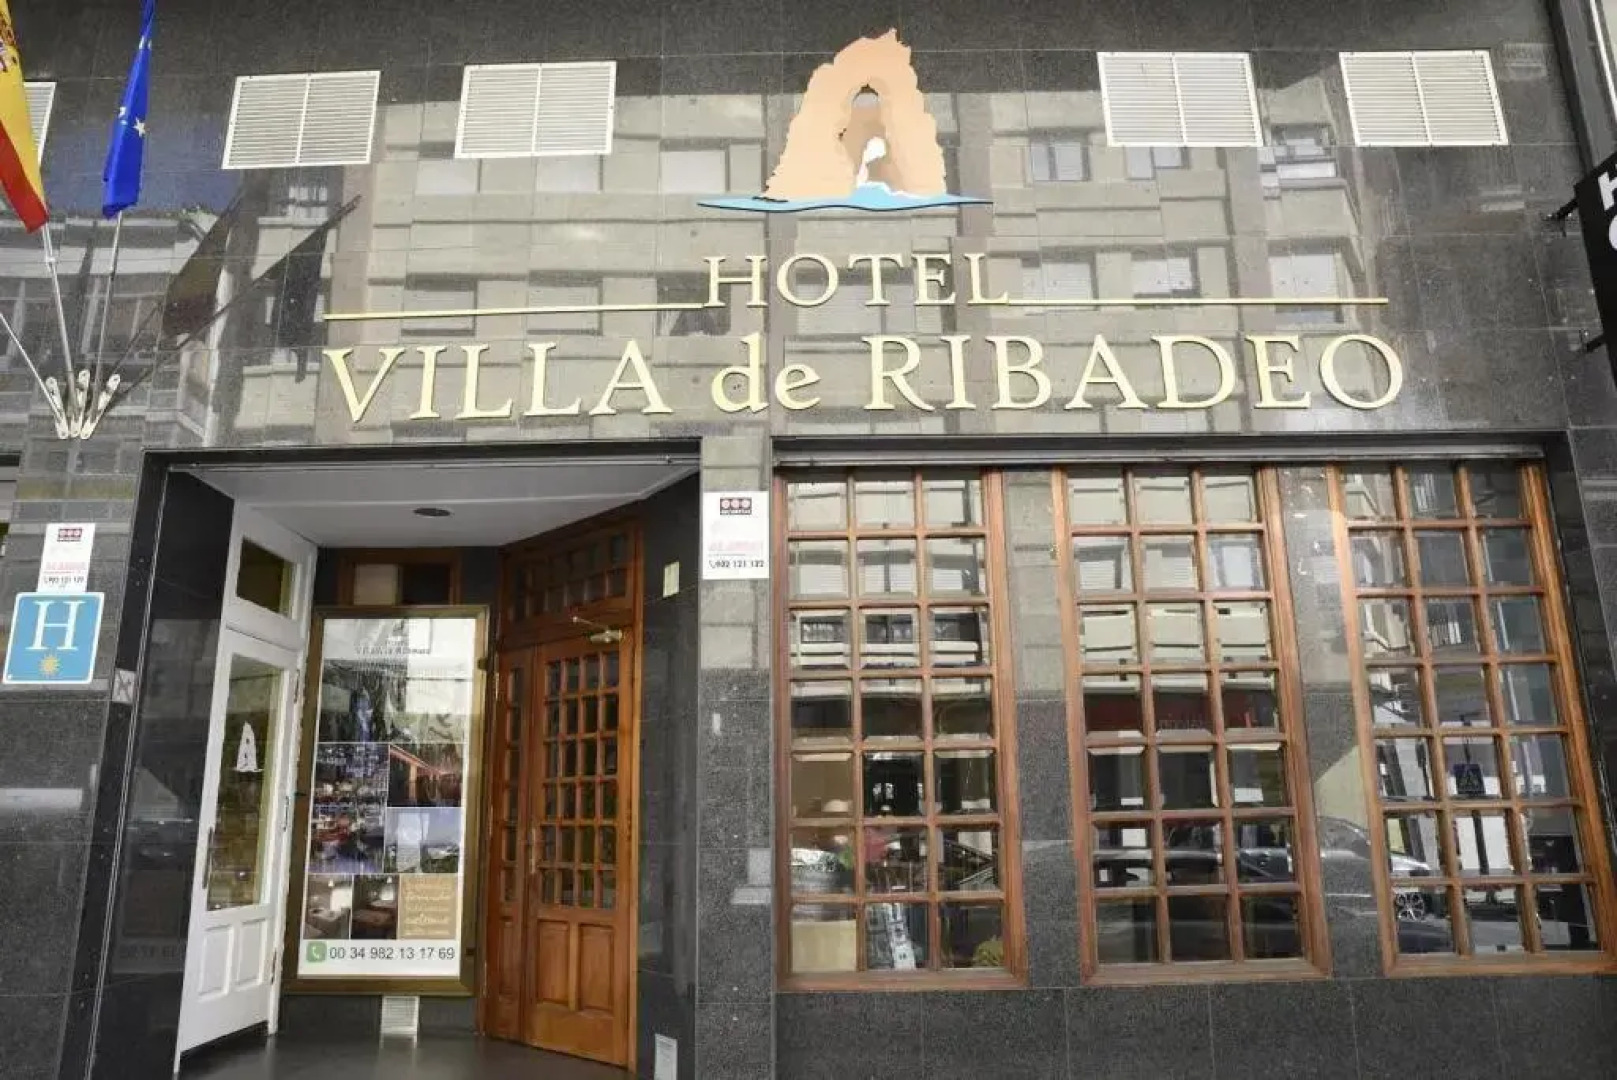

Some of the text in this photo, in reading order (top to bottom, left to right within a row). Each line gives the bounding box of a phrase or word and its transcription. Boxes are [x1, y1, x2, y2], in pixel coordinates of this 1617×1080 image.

[703, 252, 1010, 308] HOTEL
[323, 331, 1404, 423] VILLA de RIBADEO
[25, 600, 87, 651] H
[329, 946, 455, 960] 00 34 982 13 17 69
